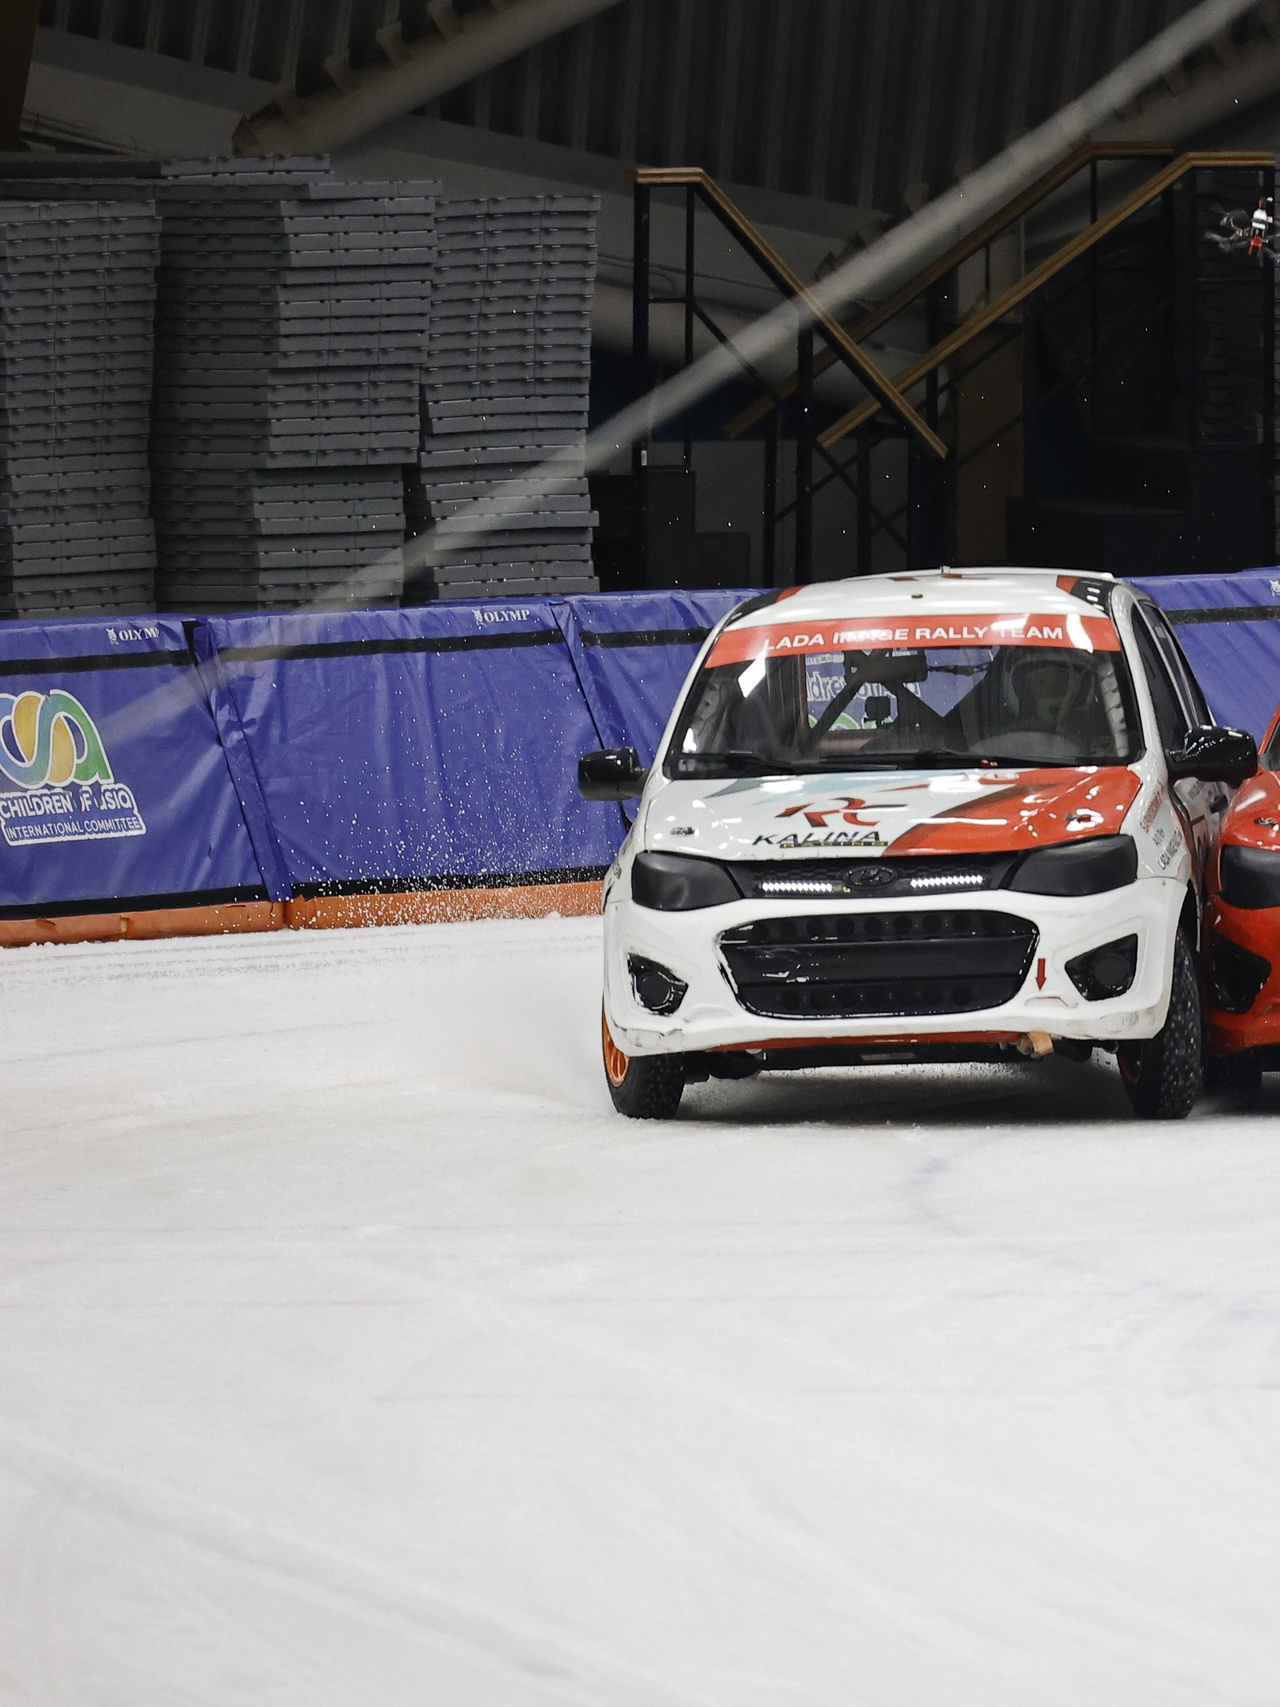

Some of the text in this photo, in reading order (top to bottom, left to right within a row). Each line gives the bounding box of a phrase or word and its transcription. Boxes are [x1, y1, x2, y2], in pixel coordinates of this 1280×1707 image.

[484, 609, 530, 622] OLYMP
[763, 633, 824, 650] LADA
[915, 627, 989, 640] RALLY
[997, 626, 1063, 640] TEAM
[0, 793, 74, 819] CHILDREN
[6, 817, 141, 839] INTERNATIONAL COMMITTEE
[752, 831, 880, 847] KALINA
